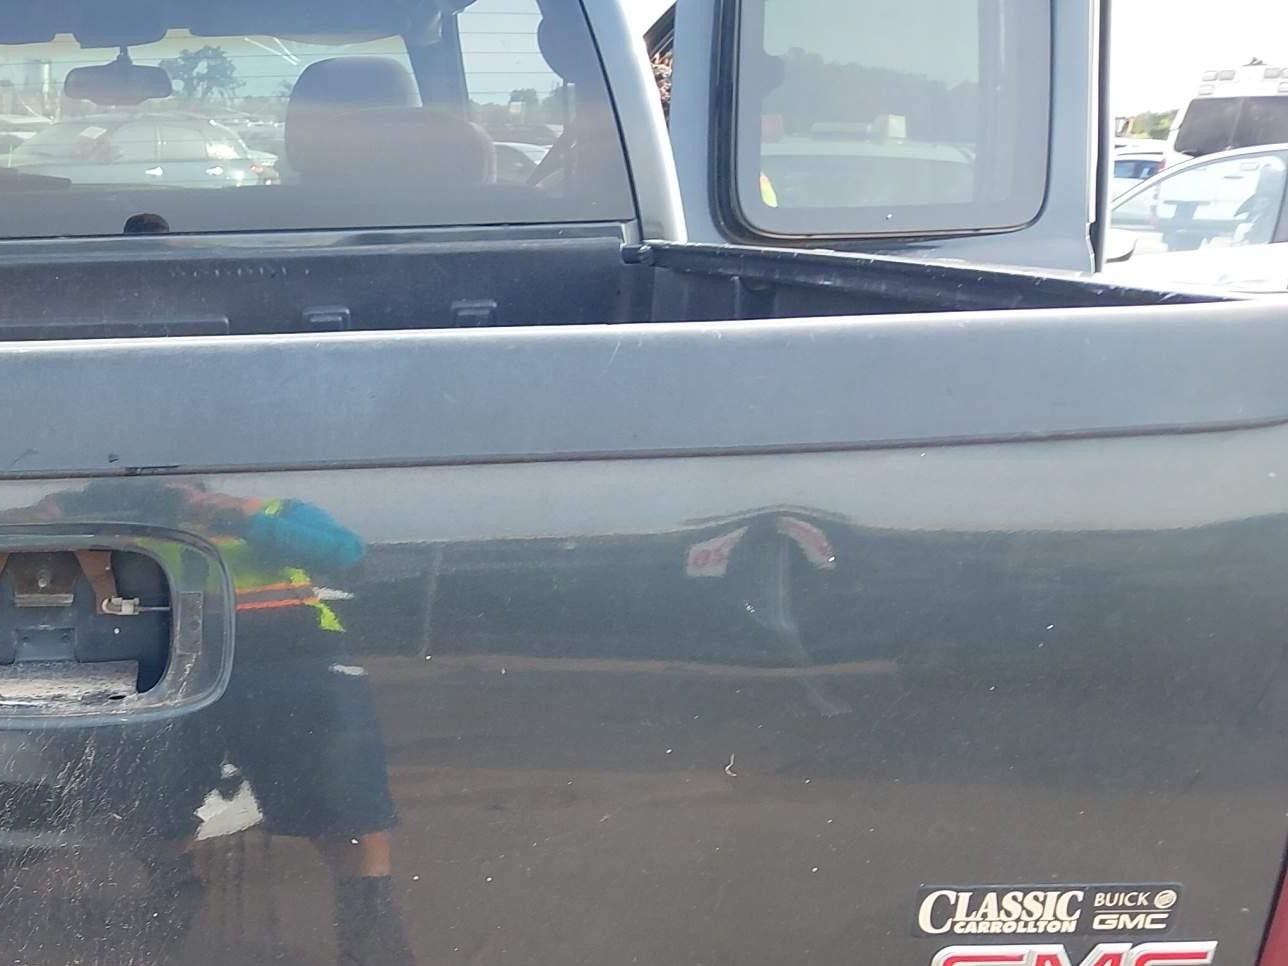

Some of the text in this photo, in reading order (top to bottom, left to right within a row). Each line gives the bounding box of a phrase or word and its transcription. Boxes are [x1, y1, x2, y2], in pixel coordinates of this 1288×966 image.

[1094, 891, 1150, 908] BUICK
[918, 889, 1084, 934] CLASSIC
[952, 919, 1077, 934] CARROLLTON
[1092, 913, 1169, 930] GMC
